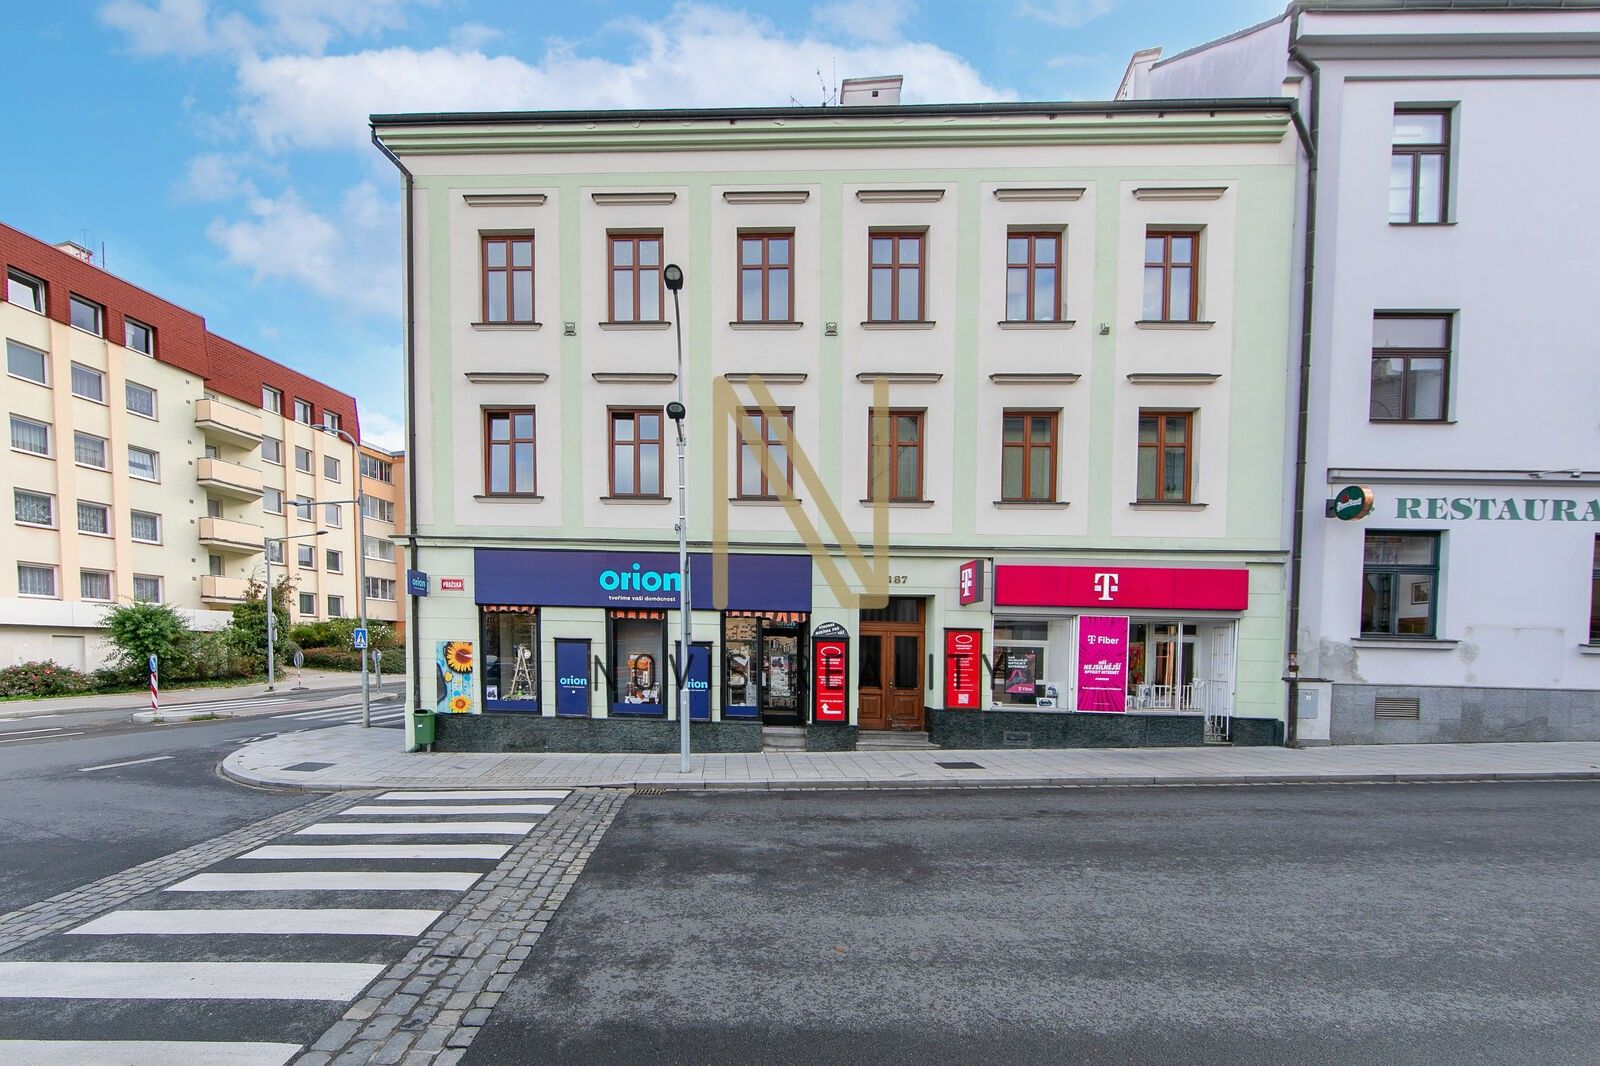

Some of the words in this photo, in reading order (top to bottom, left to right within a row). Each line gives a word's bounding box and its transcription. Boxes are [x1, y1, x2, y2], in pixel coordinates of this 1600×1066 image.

[1395, 497, 1600, 521] RESTAURA
[411, 577, 426, 588] orion
[599, 562, 682, 592] orion
[442, 580, 462, 588] PRAŽSKÁ
[1094, 573, 1119, 601] T
[1098, 636, 1119, 645] Fiber
[559, 675, 588, 686] orion
[687, 679, 708, 688] rion
